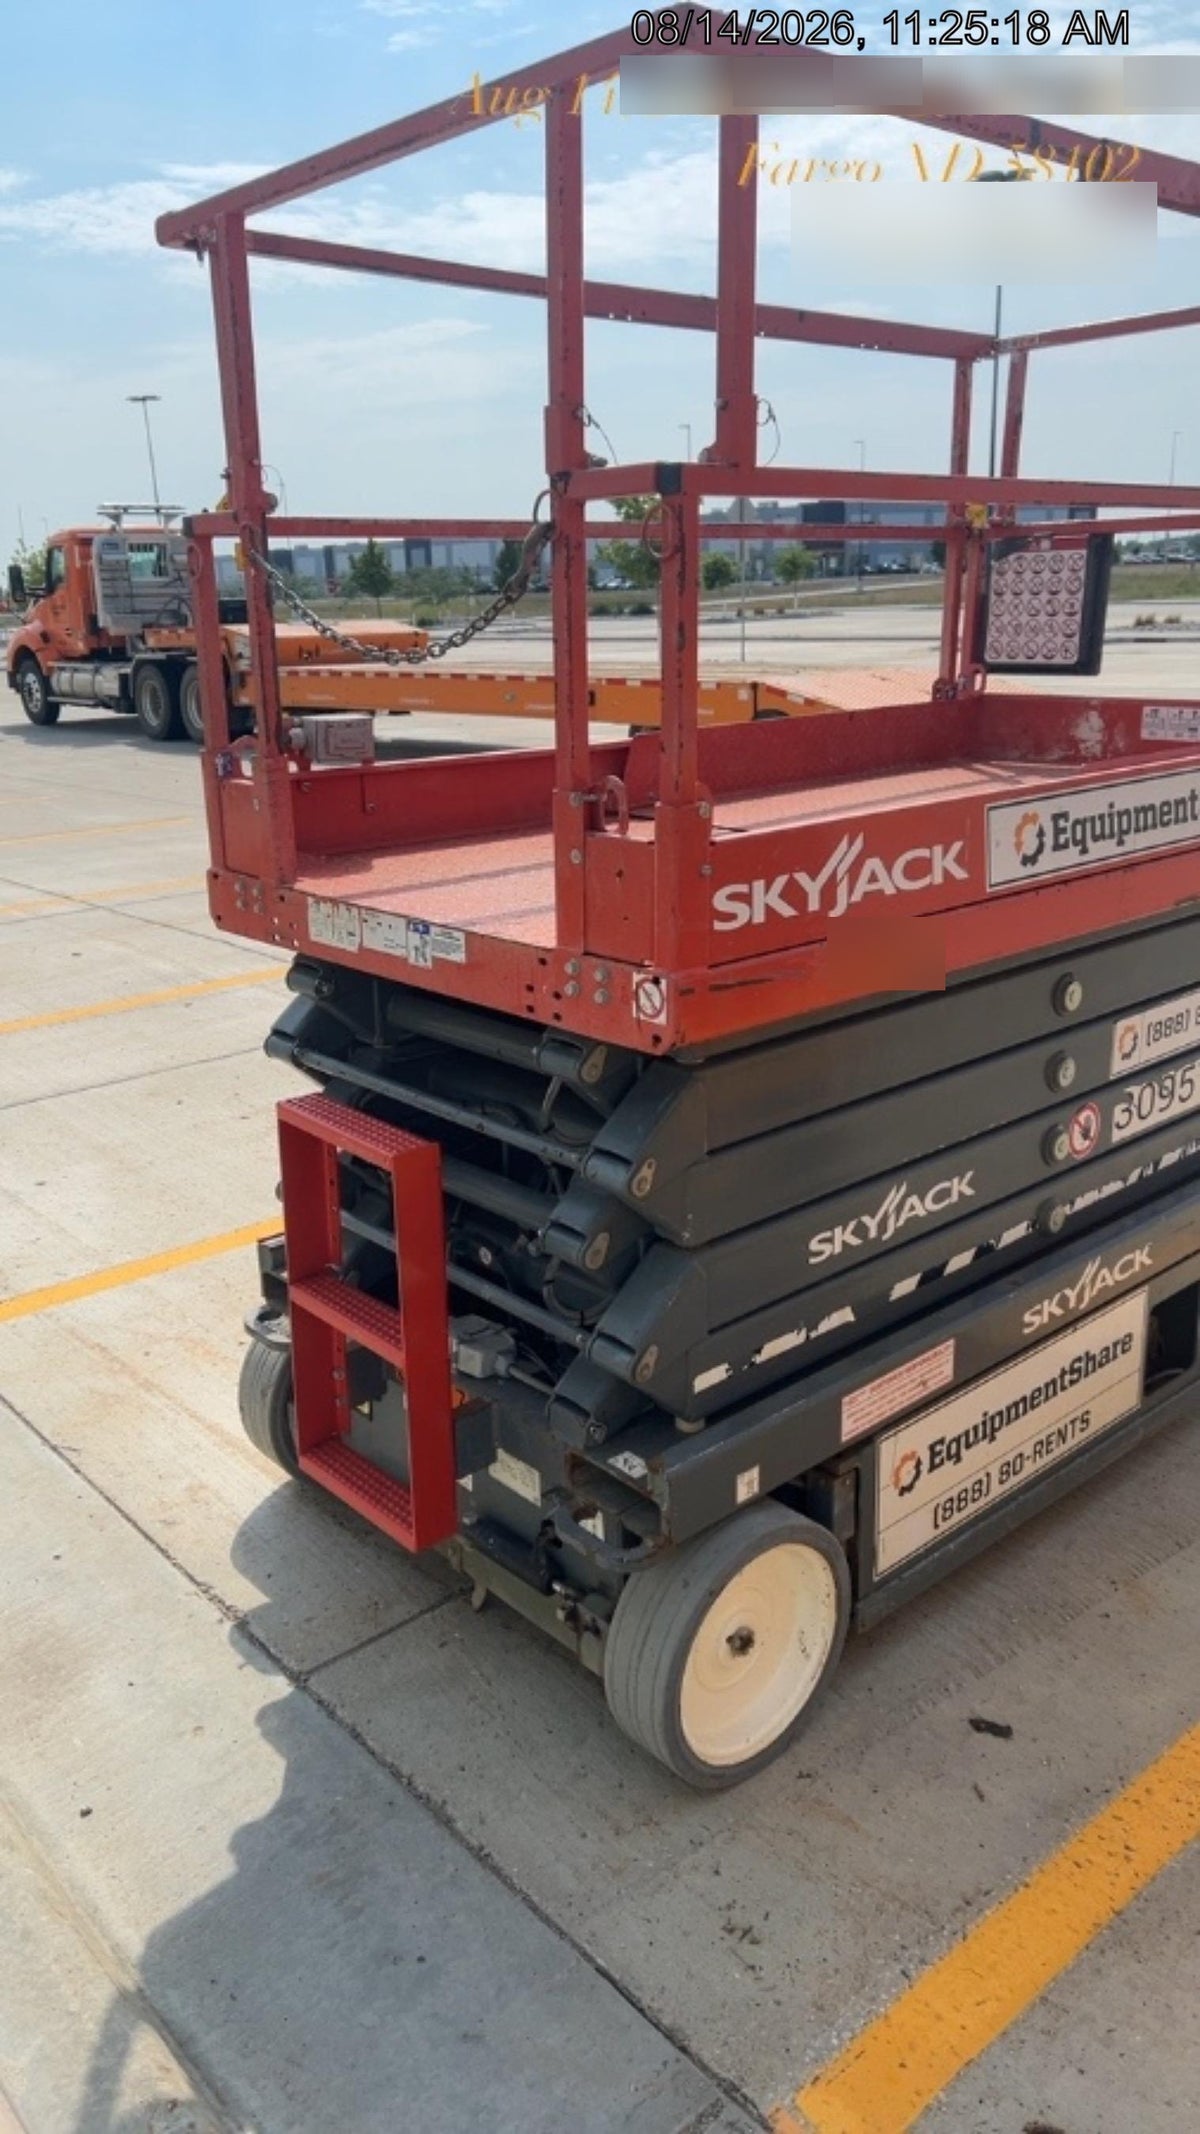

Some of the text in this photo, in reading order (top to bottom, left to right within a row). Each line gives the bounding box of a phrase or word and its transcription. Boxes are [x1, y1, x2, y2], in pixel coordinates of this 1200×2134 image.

[1051, 788, 1199, 856] Equipment
[713, 832, 969, 931] SKYJACK
[808, 1170, 976, 1265] SKYJACK
[1023, 1242, 1155, 1335] SKYJACK
[927, 1331, 1134, 1475] EquipmentShare
[933, 1409, 1092, 1530] (888) 80-RENTS
